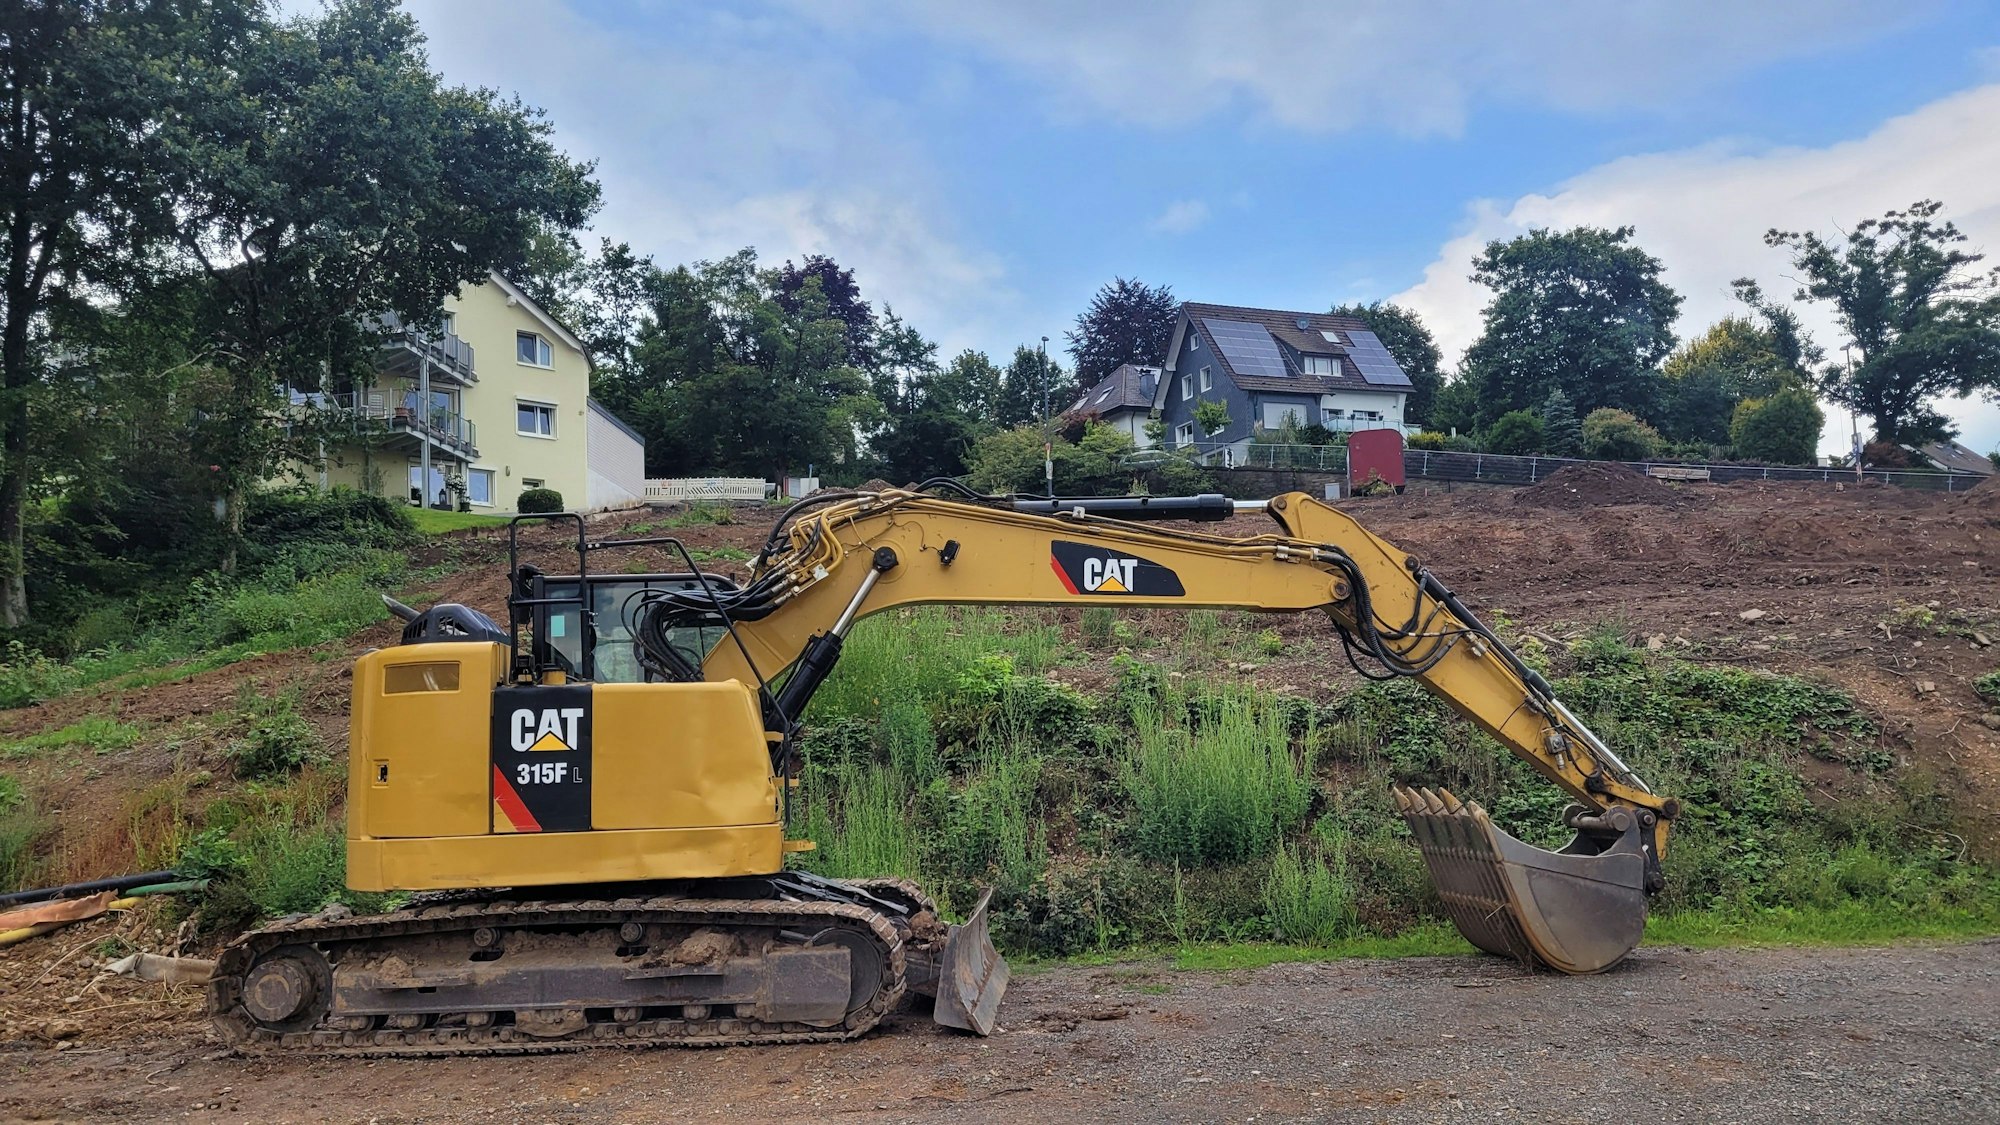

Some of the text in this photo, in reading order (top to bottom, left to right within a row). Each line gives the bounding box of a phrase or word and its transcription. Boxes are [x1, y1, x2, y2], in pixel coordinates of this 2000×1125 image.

[1083, 557, 1138, 592] CAT
[510, 707, 584, 752] CAT
[516, 762, 583, 785] 315F L
